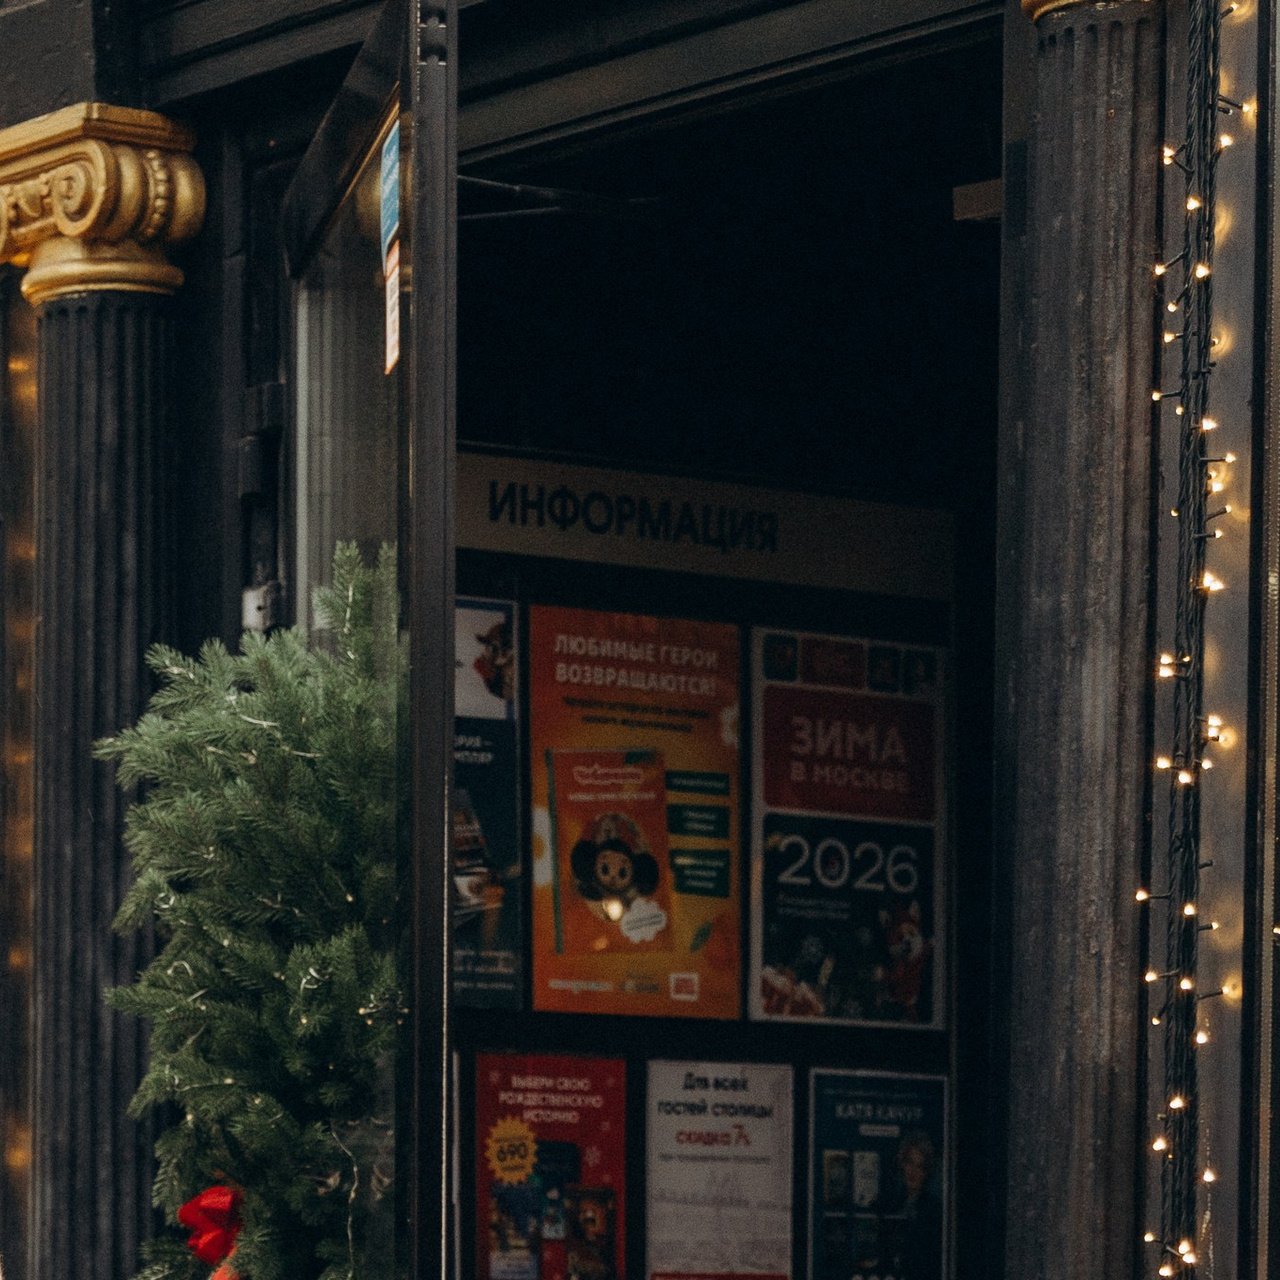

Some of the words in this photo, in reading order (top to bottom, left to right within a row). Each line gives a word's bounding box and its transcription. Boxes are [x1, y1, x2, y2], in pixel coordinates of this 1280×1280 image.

[489, 480, 779, 553] ИНФОРМАЦИЯ
[554, 634, 654, 664] ЛЮБИМЫЕ
[658, 640, 719, 668] ГЕРОИ
[554, 662, 717, 696] ВОЗВРАЩАЮТСЯ!
[790, 716, 908, 763] ЗИМА
[790, 761, 805, 783] В
[814, 764, 908, 793] МОСКВЕ
[777, 834, 919, 894] 2026
